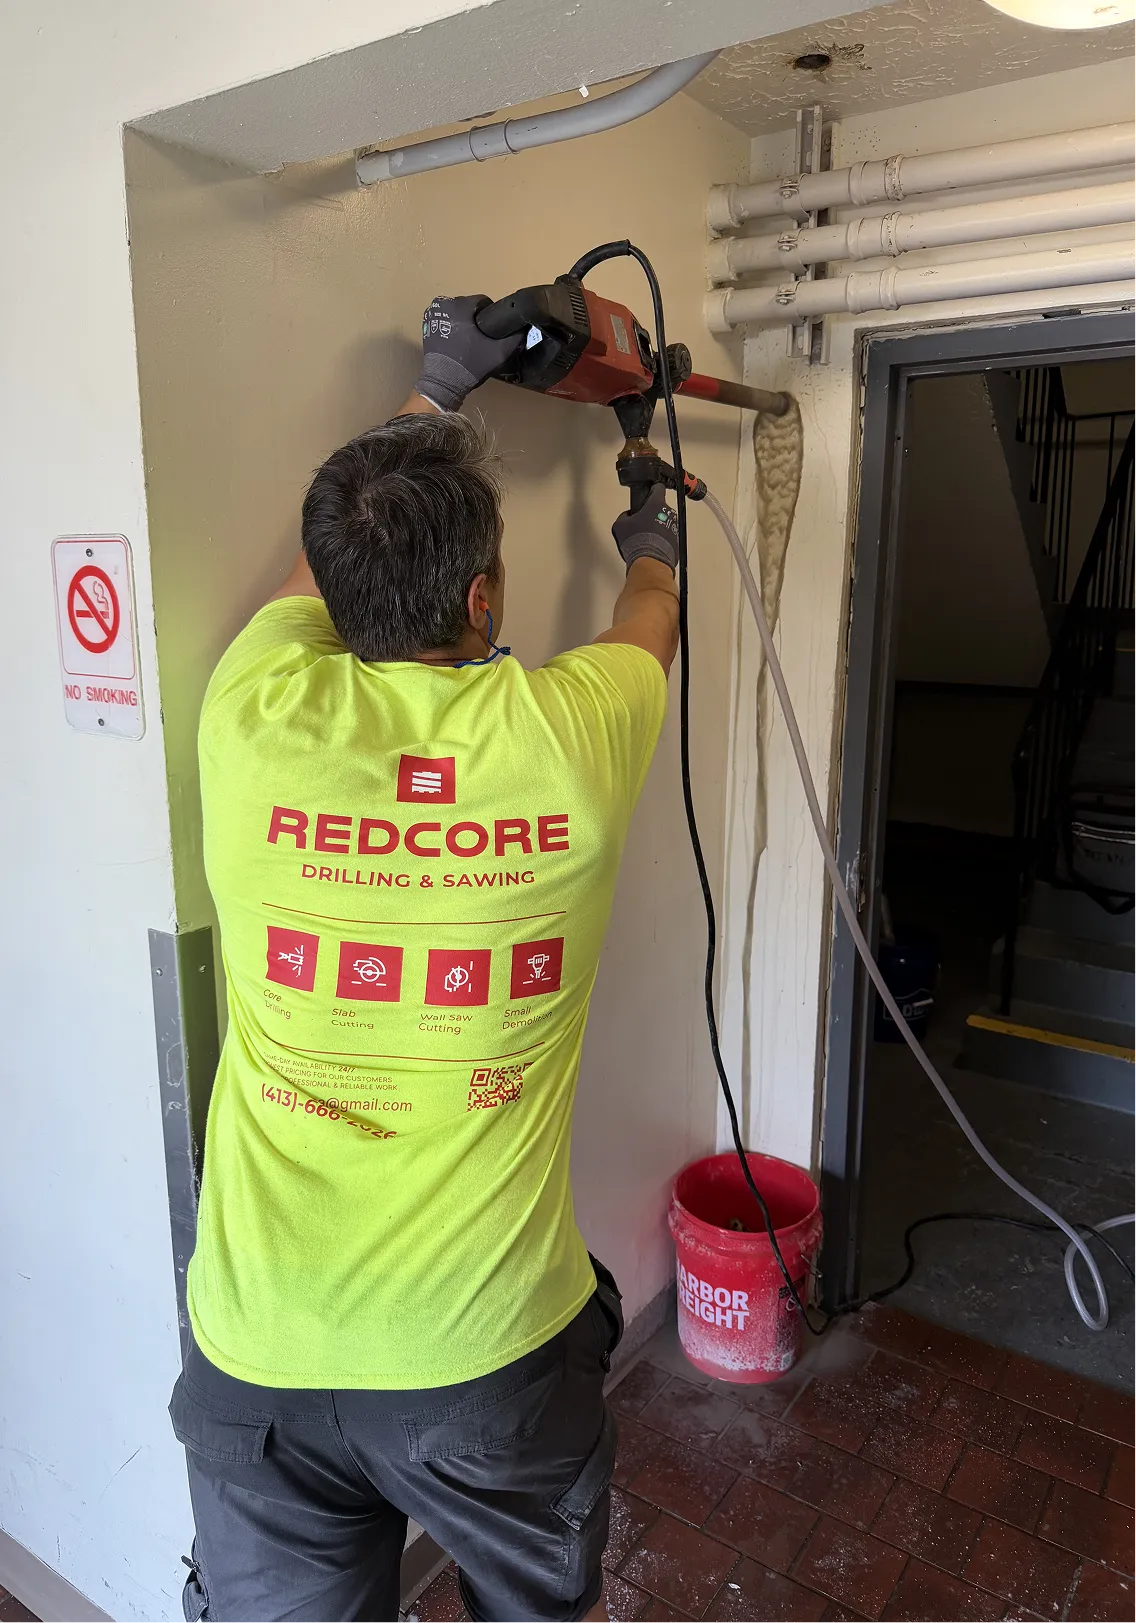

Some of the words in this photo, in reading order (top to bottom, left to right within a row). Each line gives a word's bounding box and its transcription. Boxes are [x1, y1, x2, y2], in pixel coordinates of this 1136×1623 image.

[65, 684, 82, 701] NO
[86, 686, 138, 706] SMOKING
[266, 805, 570, 858] REDCORE
[301, 863, 411, 888] DRILLING
[419, 874, 434, 888] &
[442, 870, 535, 888] SAWING
[263, 989, 282, 1002] Core
[331, 1008, 356, 1018] Slab
[420, 1013, 445, 1021] Wall
[504, 1006, 531, 1018] Small
[331, 1019, 374, 1030] Cutting
[418, 1022, 461, 1036] Cutting
[292, 1060, 336, 1072] AVAILABILITY
[338, 1065, 356, 1074] 24/7
[285, 1067, 312, 1078] PRICING
[313, 1071, 327, 1079] FOR
[328, 1073, 345, 1081] OUR
[345, 1075, 393, 1083] CUSTOMERS
[678, 1280, 750, 1331] REIGHT
